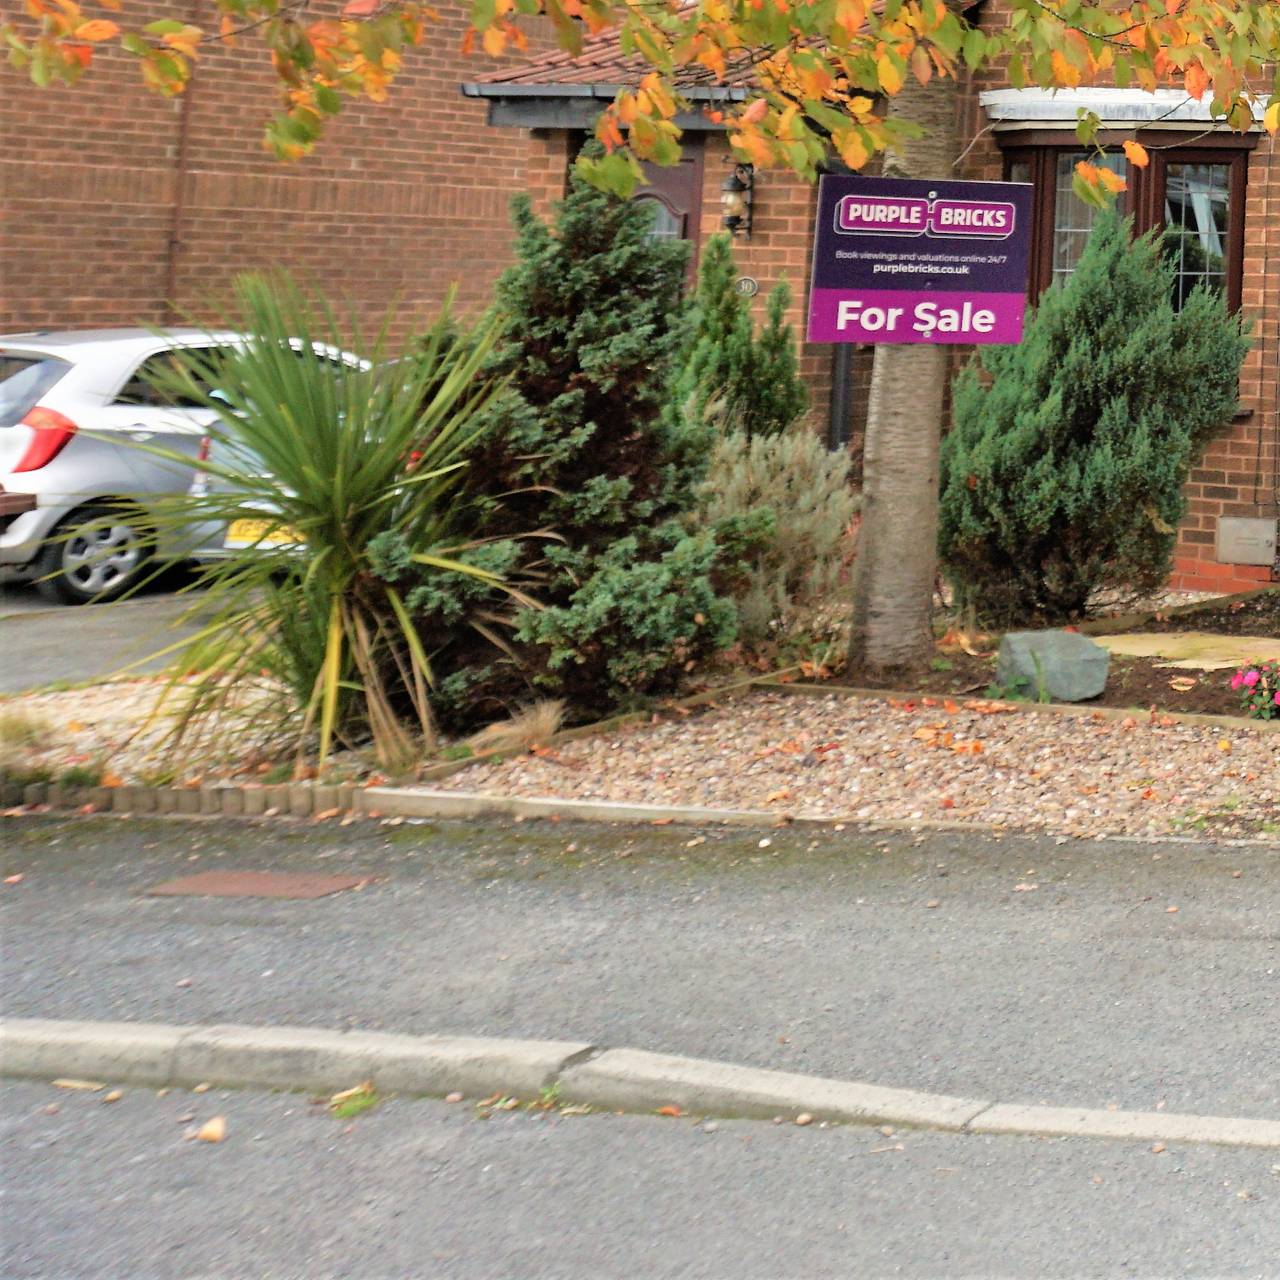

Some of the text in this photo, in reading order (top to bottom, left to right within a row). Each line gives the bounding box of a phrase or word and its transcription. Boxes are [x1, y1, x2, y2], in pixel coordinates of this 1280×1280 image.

[848, 204, 1006, 228] PURPLE BRICKS
[835, 250, 1007, 264] Book viewings and valuations online 24/7
[873, 263, 969, 274] purplebricks.co.uk
[836, 300, 996, 333] For Sale
